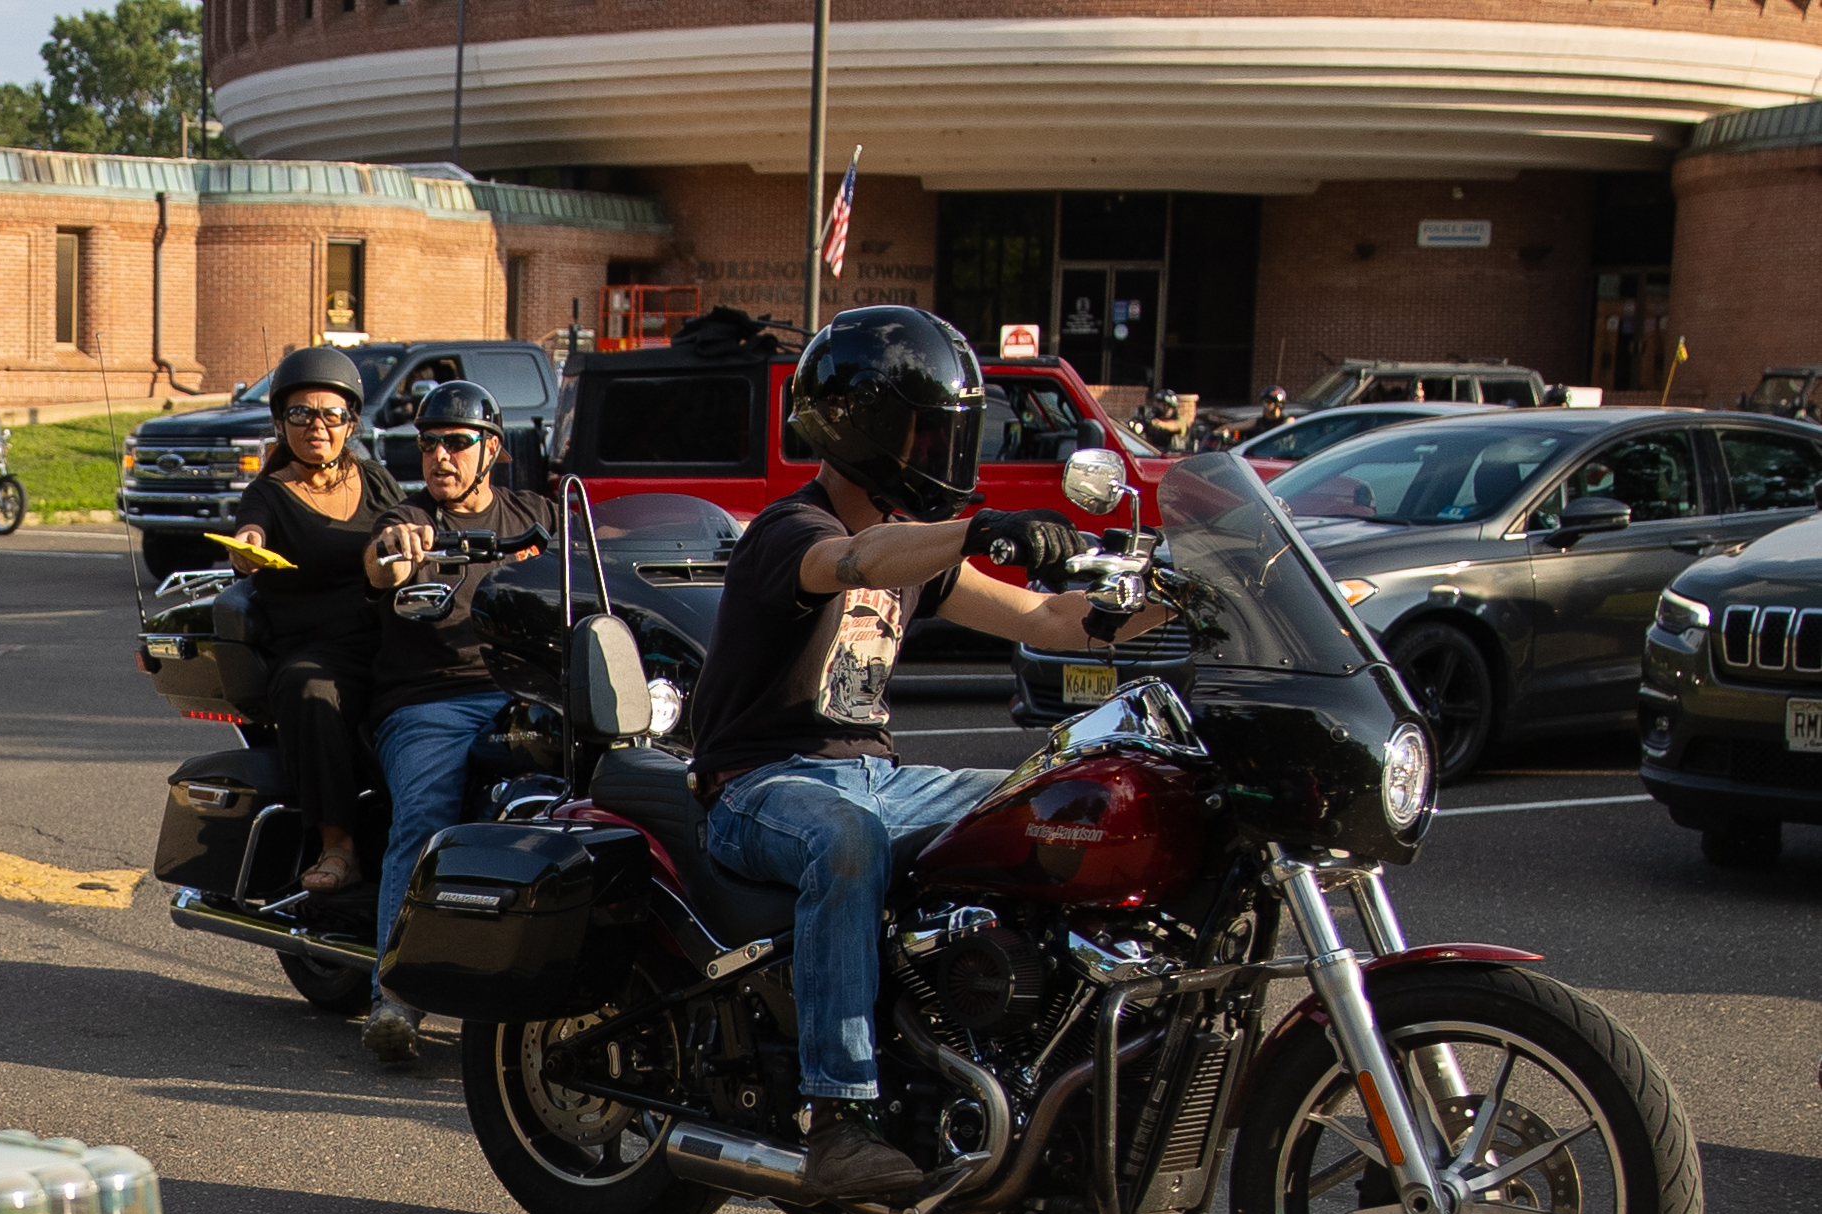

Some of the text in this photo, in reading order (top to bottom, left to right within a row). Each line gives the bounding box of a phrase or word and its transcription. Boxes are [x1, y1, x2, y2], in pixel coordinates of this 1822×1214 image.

[1066, 674, 1086, 694] K64
[1794, 712, 1822, 738] RM
[1025, 822, 1104, 843] Harley-Davidson
